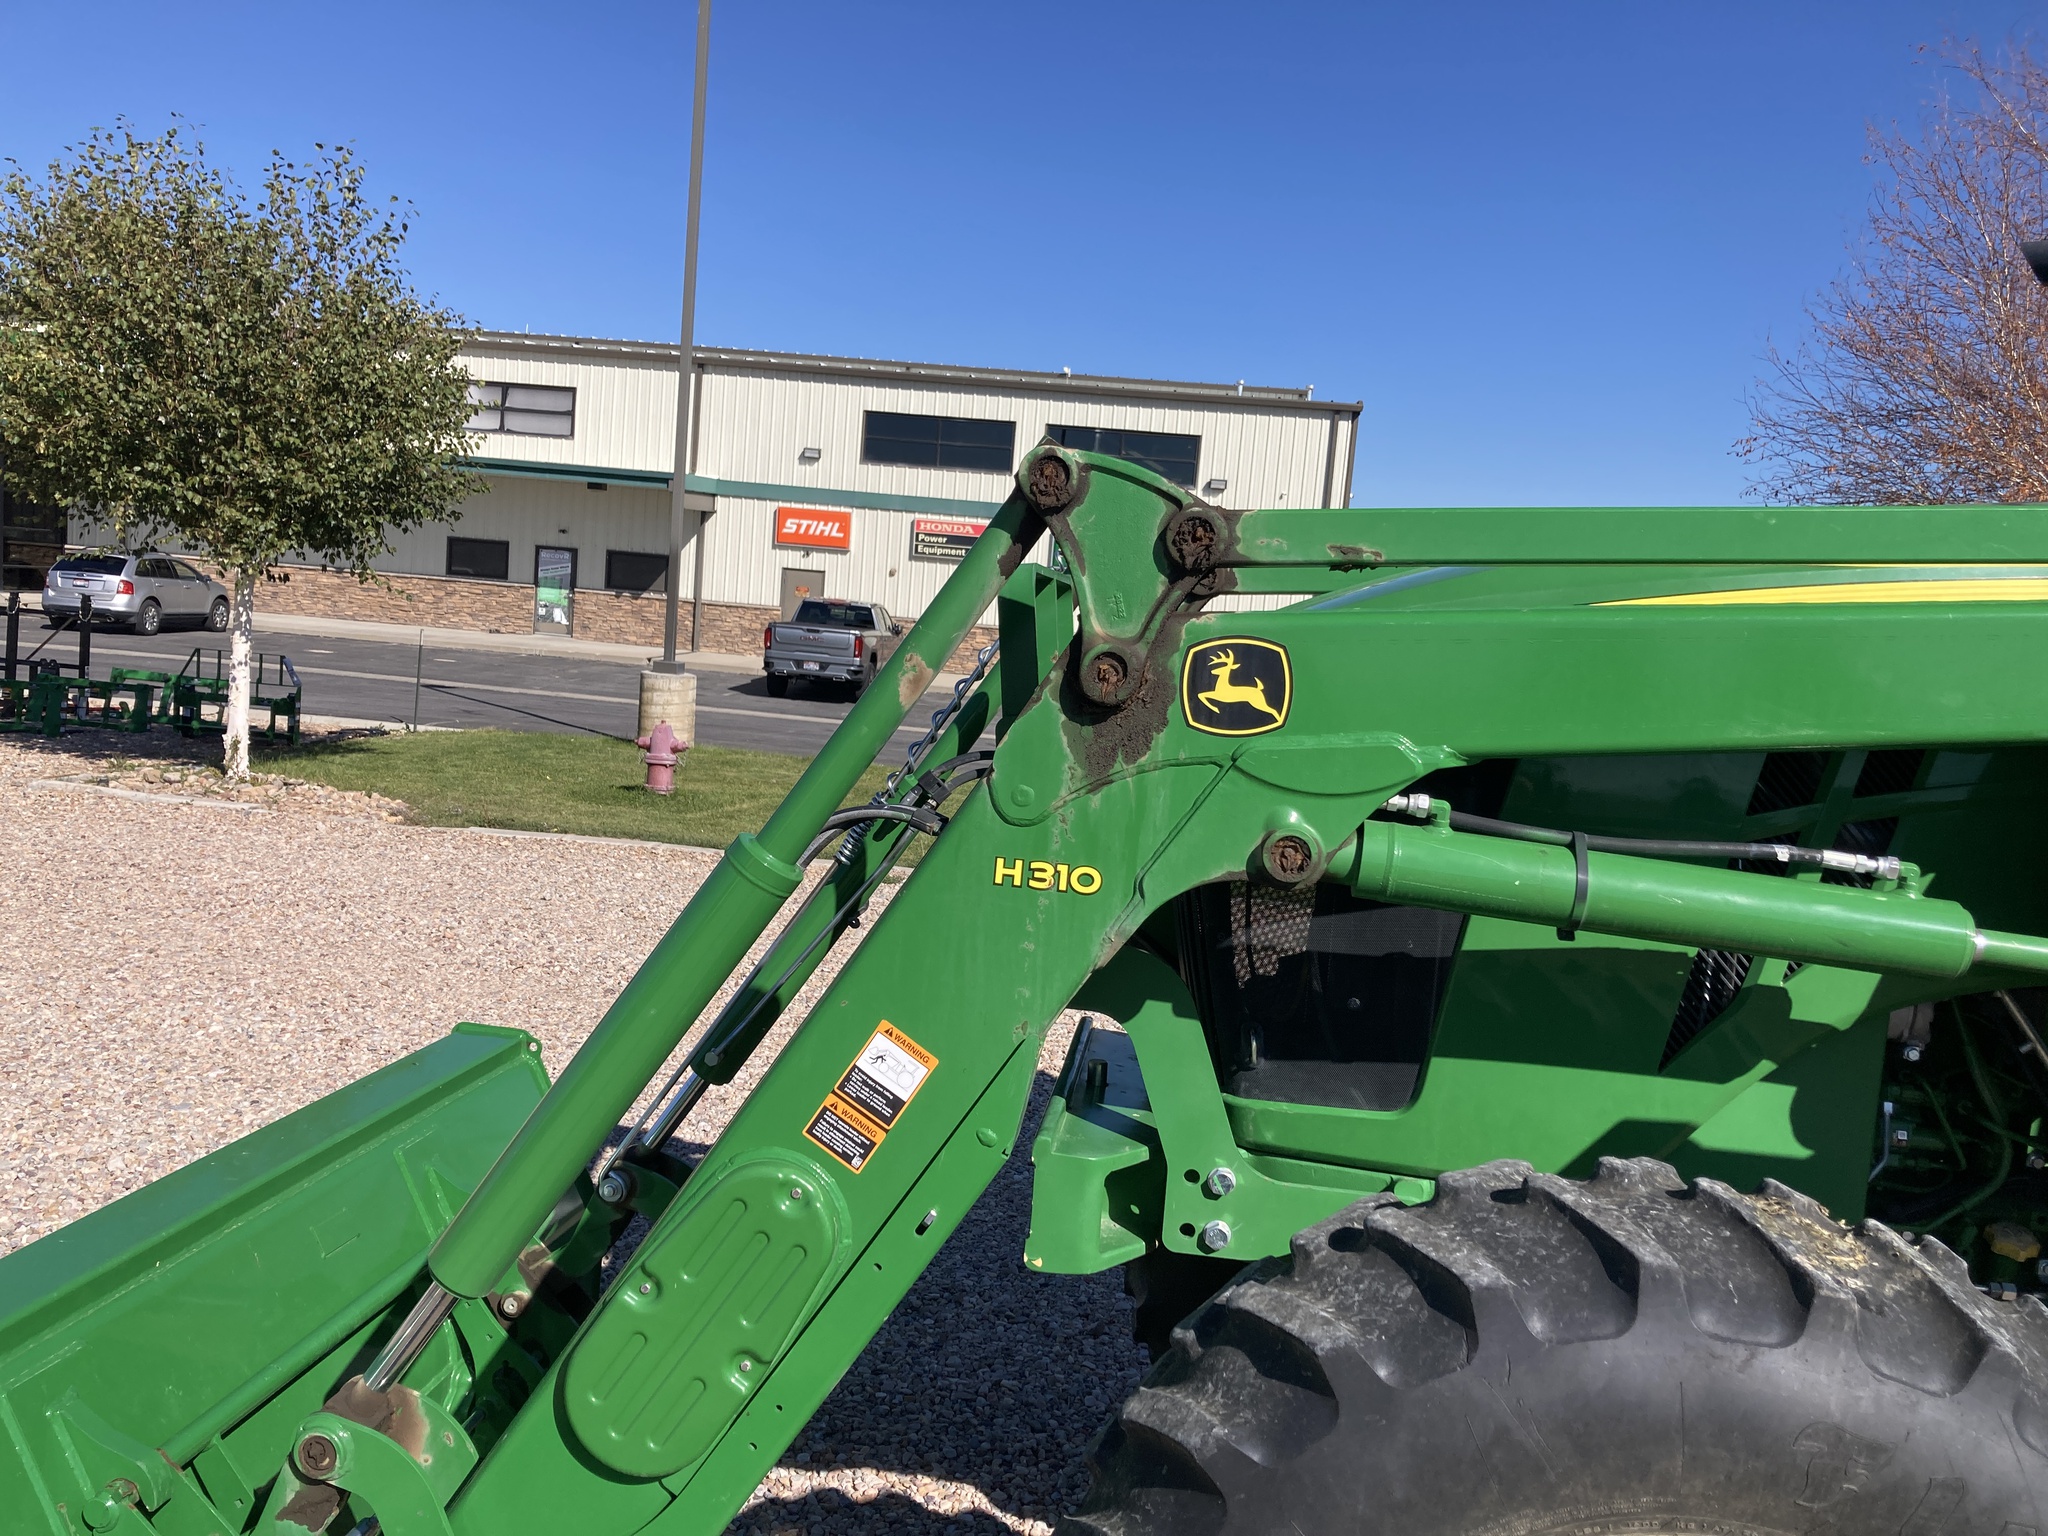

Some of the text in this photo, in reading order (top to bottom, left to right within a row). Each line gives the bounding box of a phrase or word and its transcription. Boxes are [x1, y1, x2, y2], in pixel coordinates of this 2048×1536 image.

[782, 518, 844, 538] STIHL
[919, 521, 974, 535] HONDA
[918, 534, 948, 544] Power
[917, 544, 966, 557] Equipment
[893, 1033, 930, 1063] WARNING
[840, 1108, 877, 1137] WARNING
